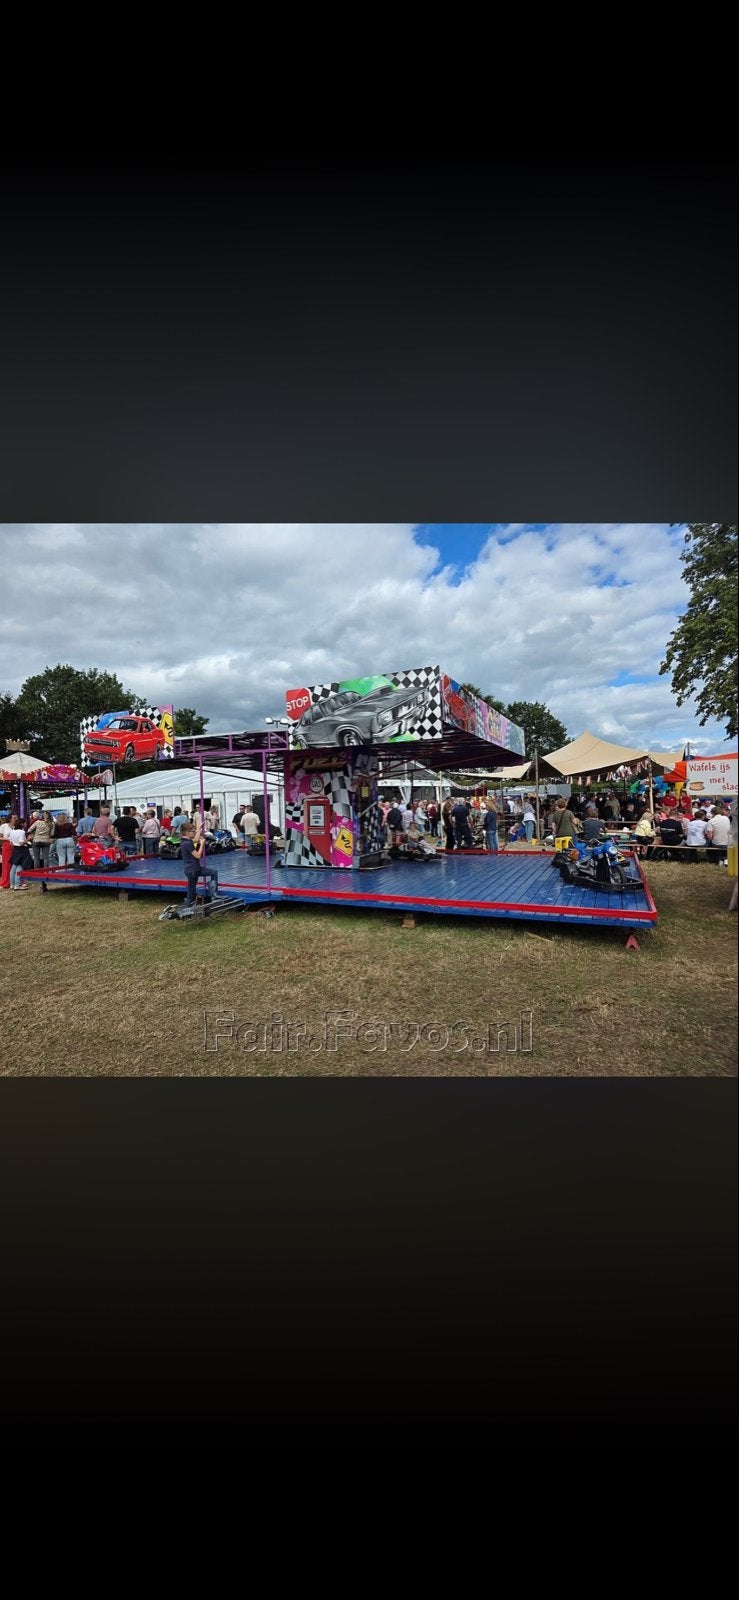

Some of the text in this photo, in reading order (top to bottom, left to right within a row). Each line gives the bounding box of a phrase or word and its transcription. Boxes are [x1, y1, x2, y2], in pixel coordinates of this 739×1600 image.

[286, 696, 309, 711] STOP
[689, 762, 731, 773] Wafels ijs
